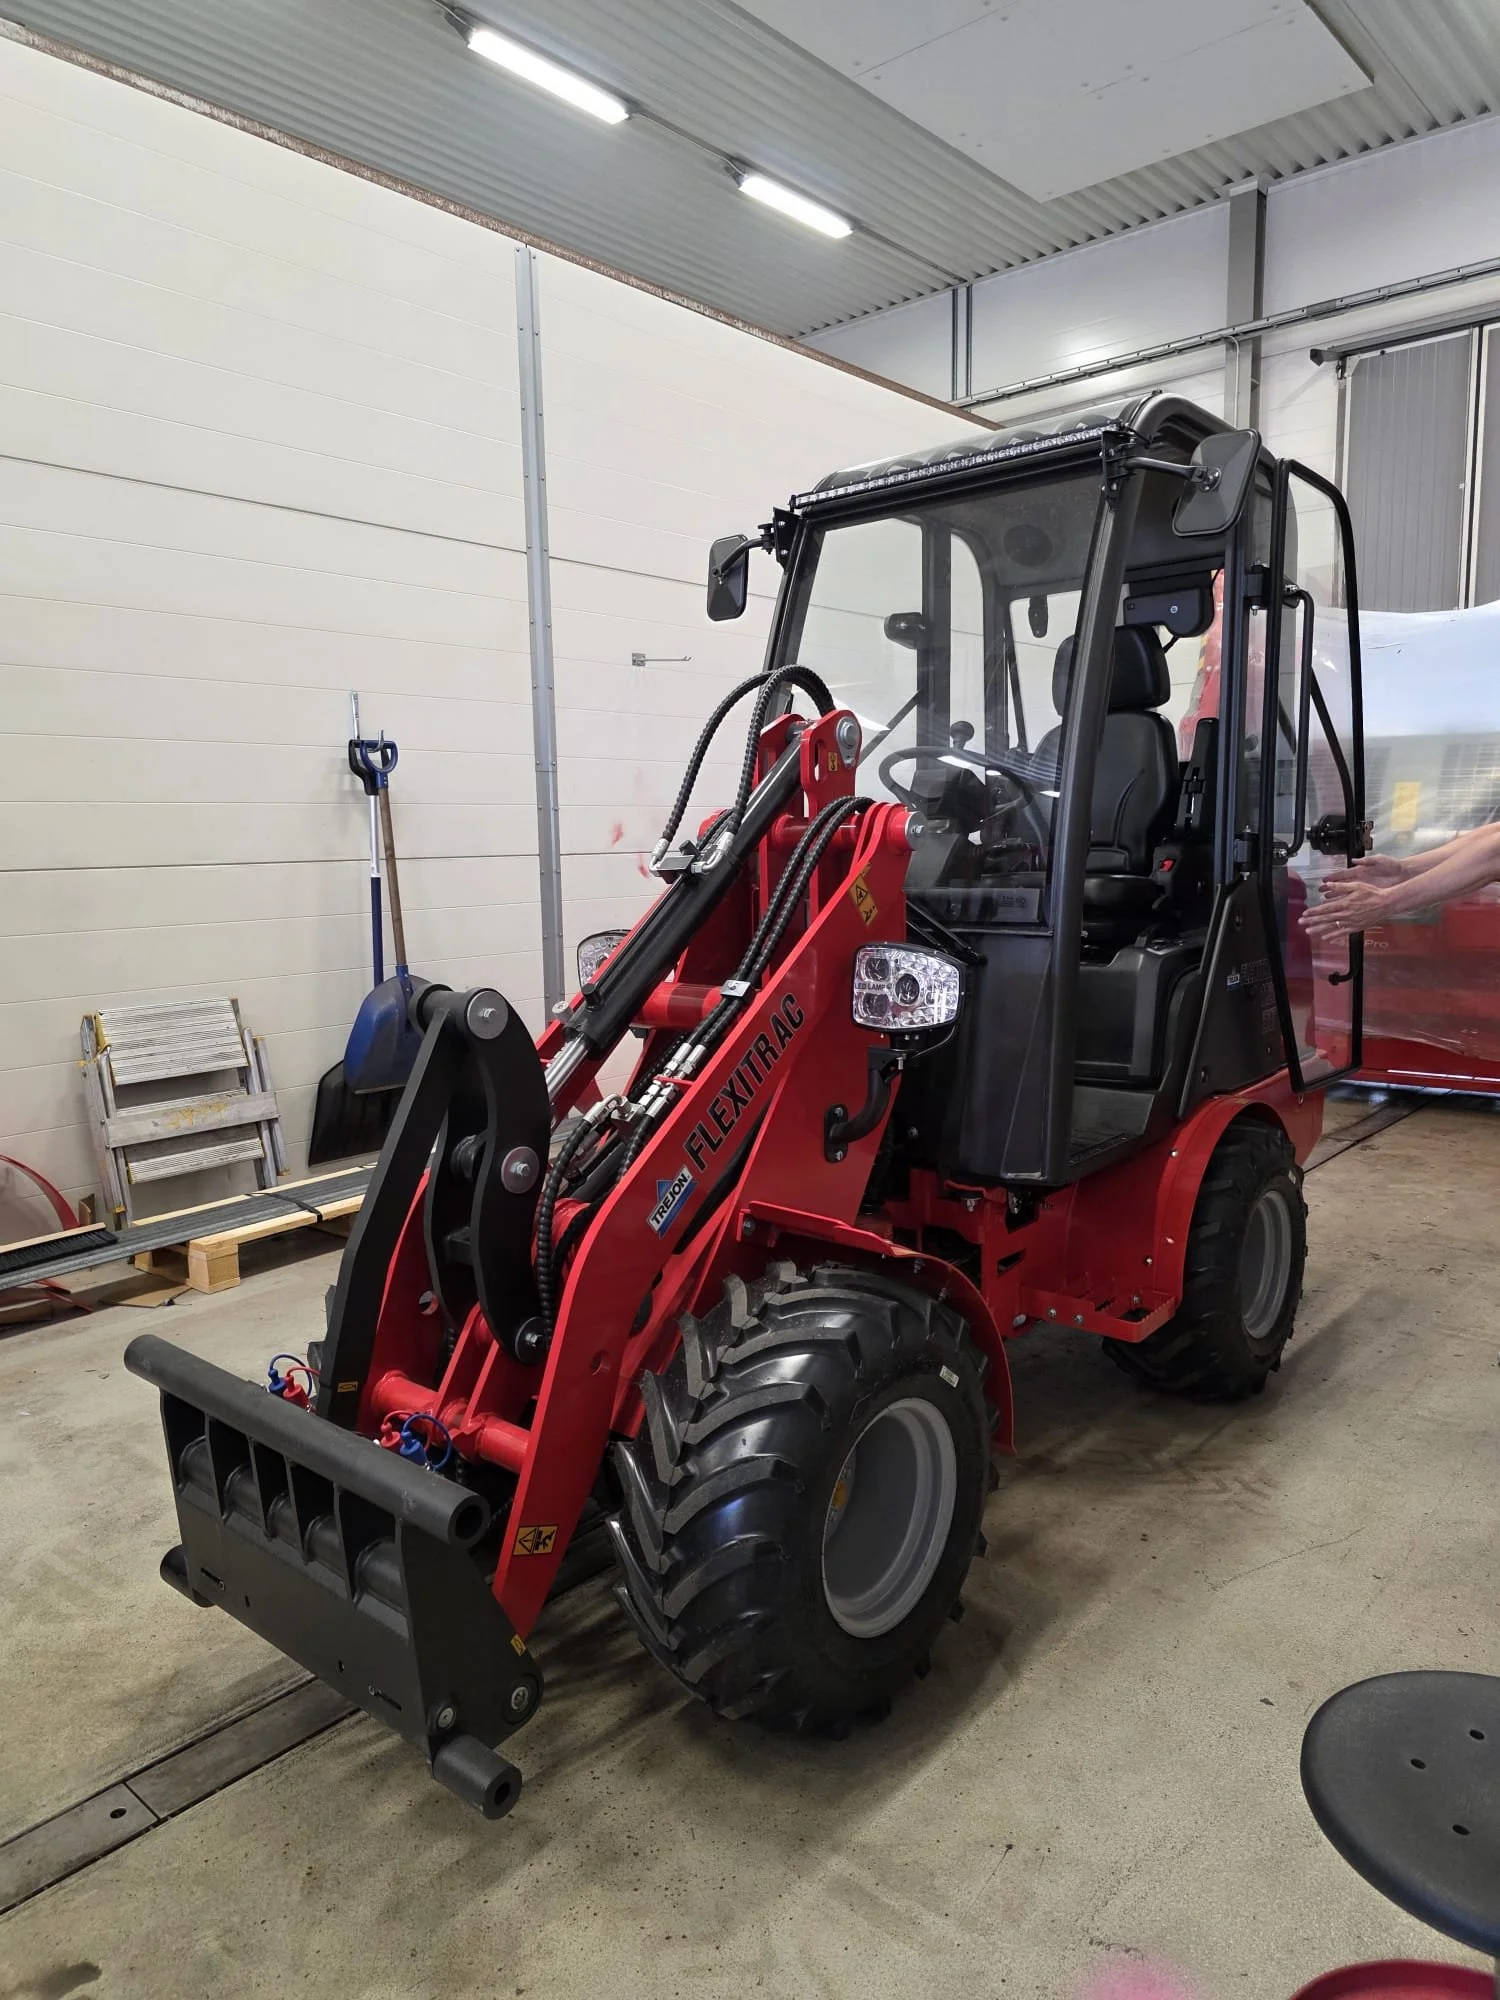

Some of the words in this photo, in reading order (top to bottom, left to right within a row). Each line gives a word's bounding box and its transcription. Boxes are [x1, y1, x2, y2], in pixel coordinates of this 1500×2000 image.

[868, 983, 886, 991] LAMP
[683, 992, 805, 1172] FLEXITRAC
[650, 1172, 690, 1225] TREJON
